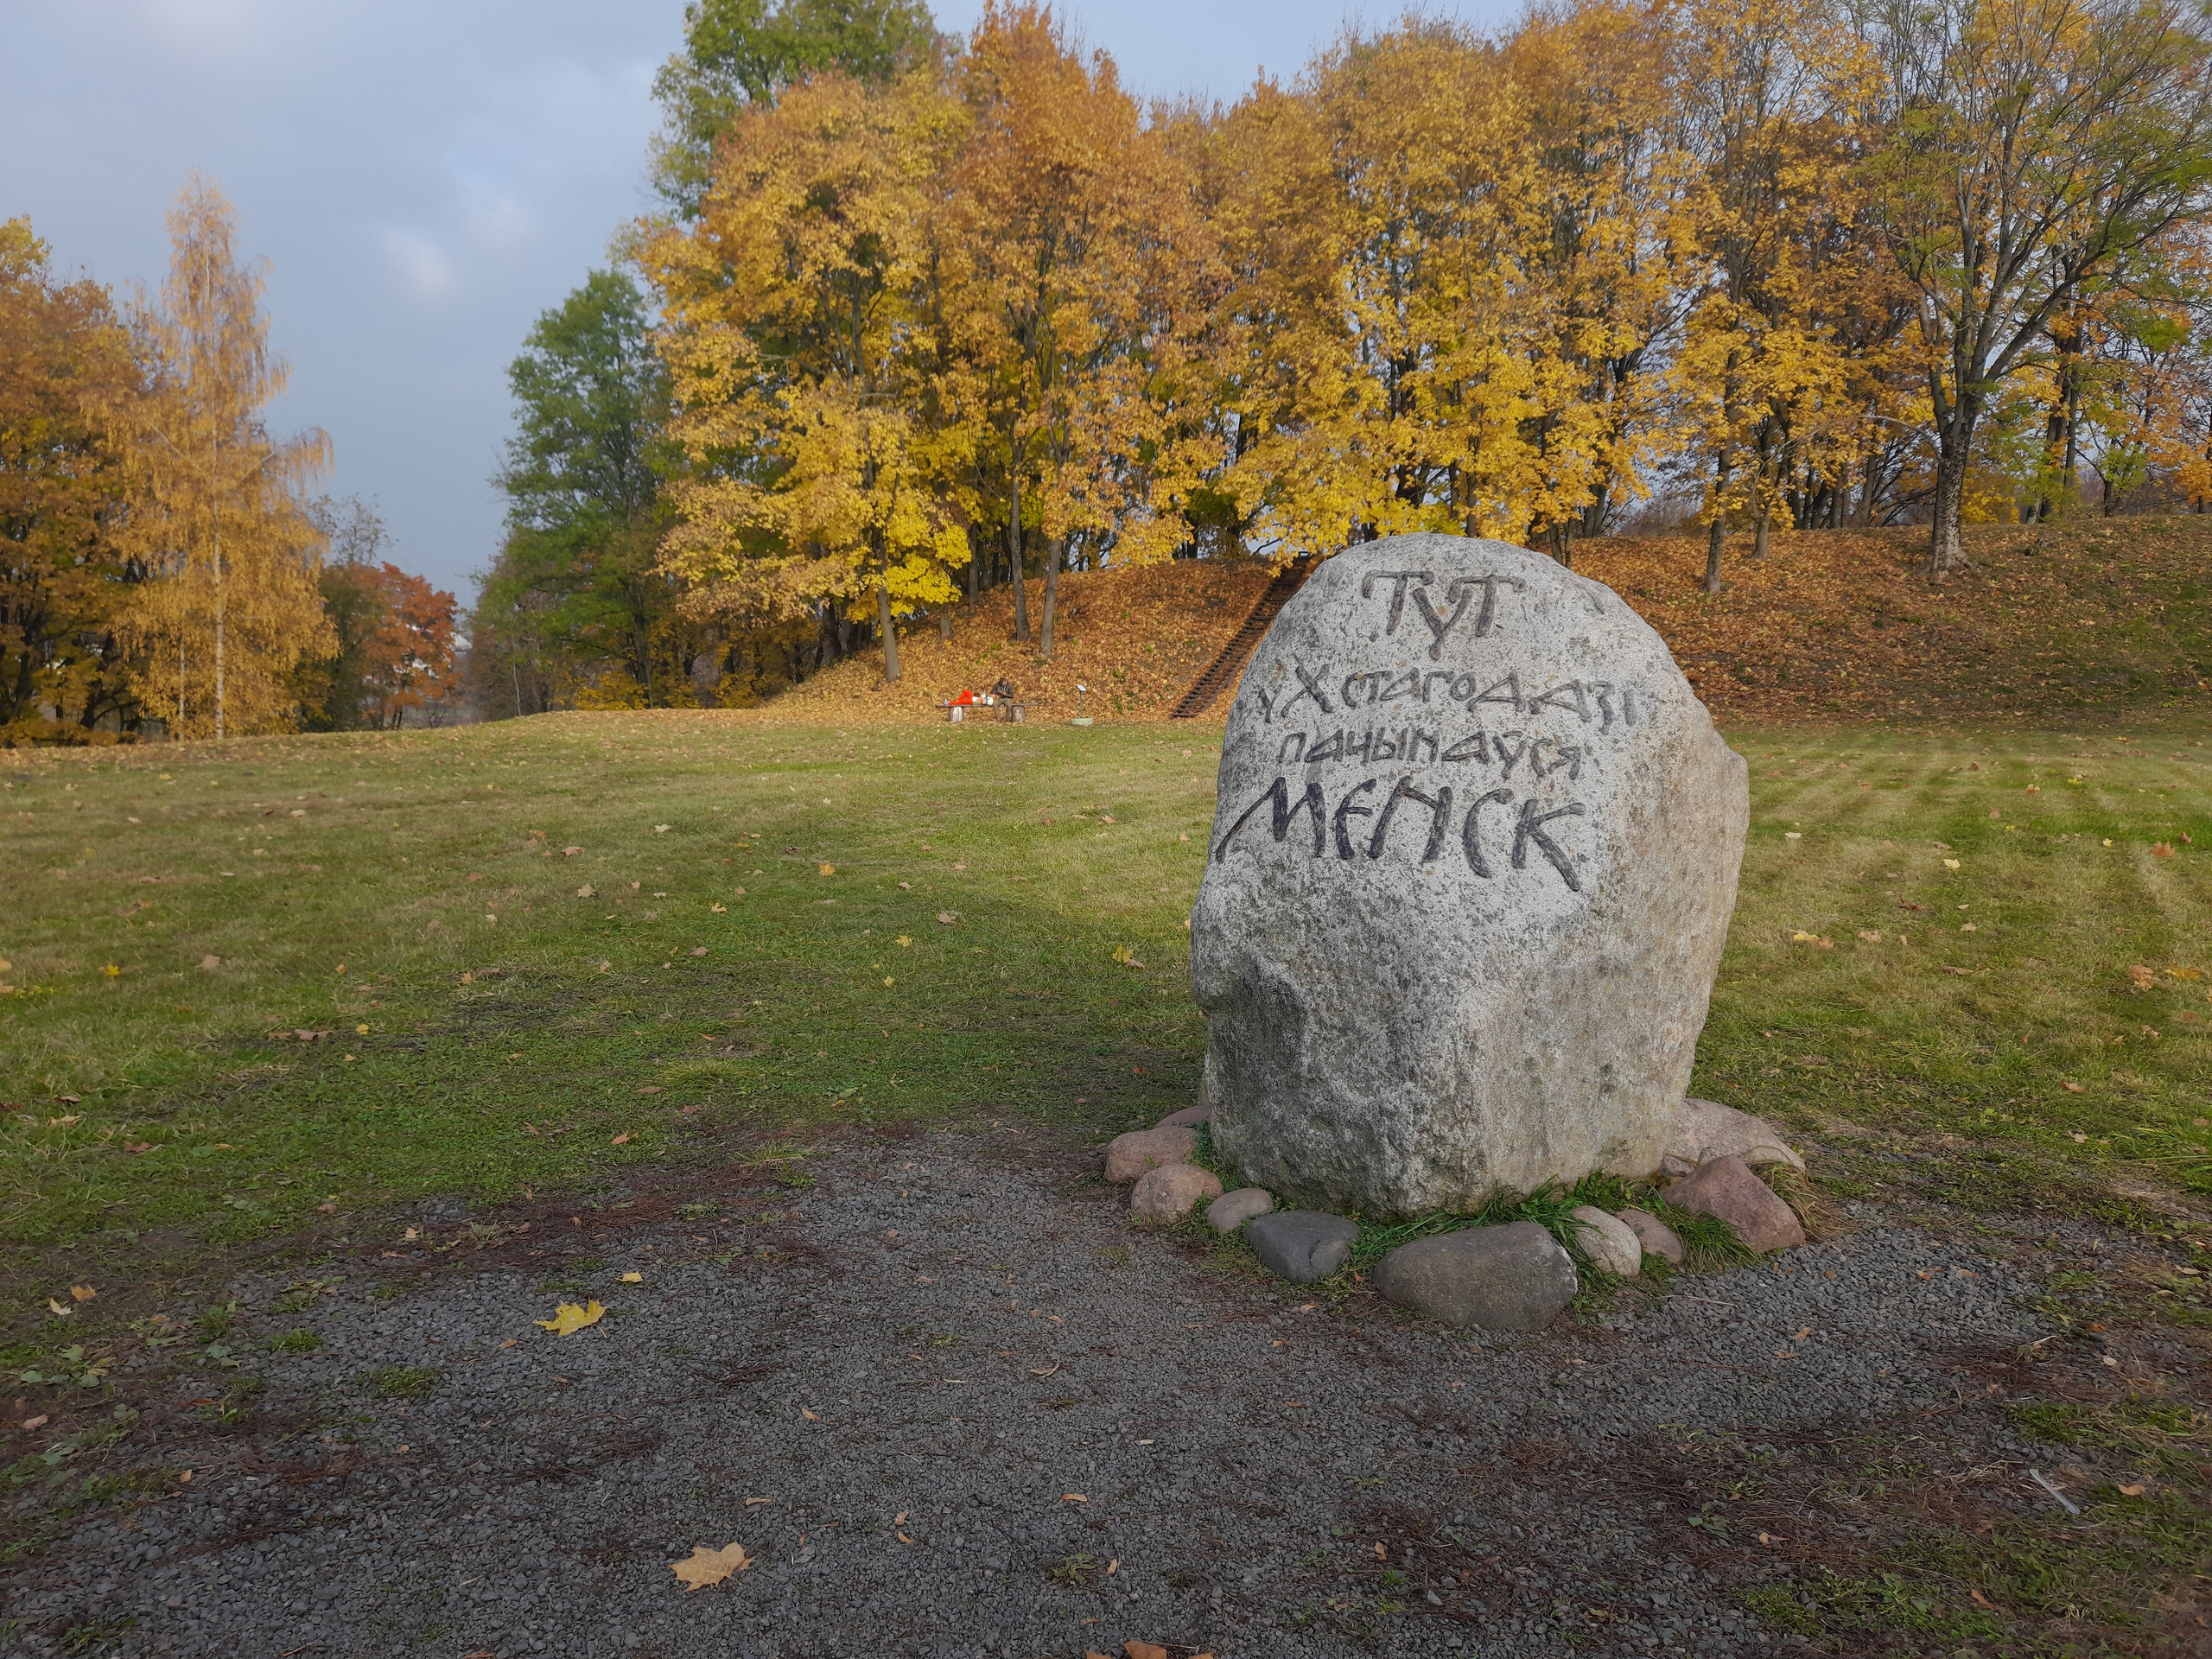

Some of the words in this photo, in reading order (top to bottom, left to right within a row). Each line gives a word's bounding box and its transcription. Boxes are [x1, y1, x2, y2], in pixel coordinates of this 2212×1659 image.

[1361, 569, 1528, 660] ТУТ
[1258, 684, 1283, 723] У
[1215, 776, 1587, 892] МЕНСК
